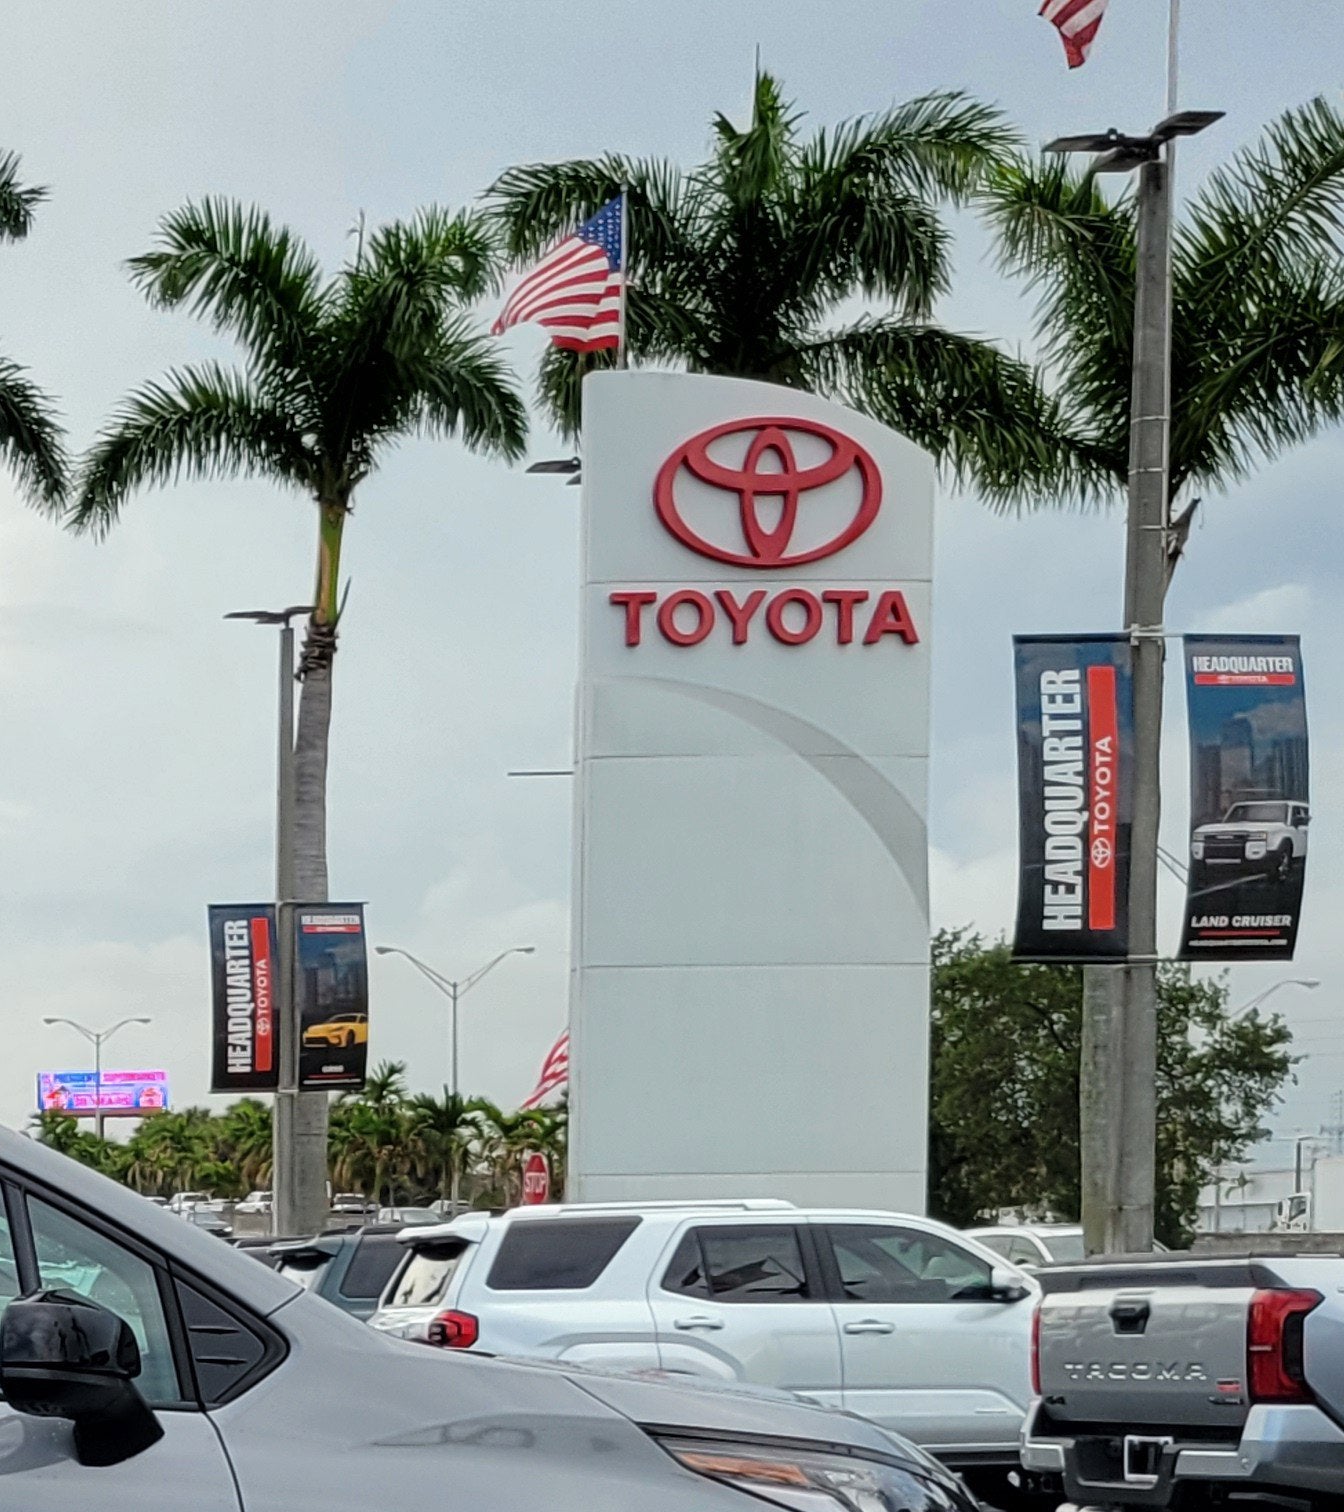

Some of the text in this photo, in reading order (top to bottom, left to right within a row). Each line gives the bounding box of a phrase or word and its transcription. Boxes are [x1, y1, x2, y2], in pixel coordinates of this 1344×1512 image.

[608, 588, 920, 647] TOYOTA
[1192, 655, 1294, 674] HEADQUARTER
[1039, 668, 1089, 931] HEADQUARTER
[1093, 735, 1112, 835] TOYOTA
[1190, 914, 1292, 928] LAND CRUISER
[224, 918, 255, 1074] HEADQUARTER
[255, 958, 268, 1016] TOYOTA
[524, 1171, 547, 1194] STOP
[1063, 1362, 1208, 1381] TACOMA
